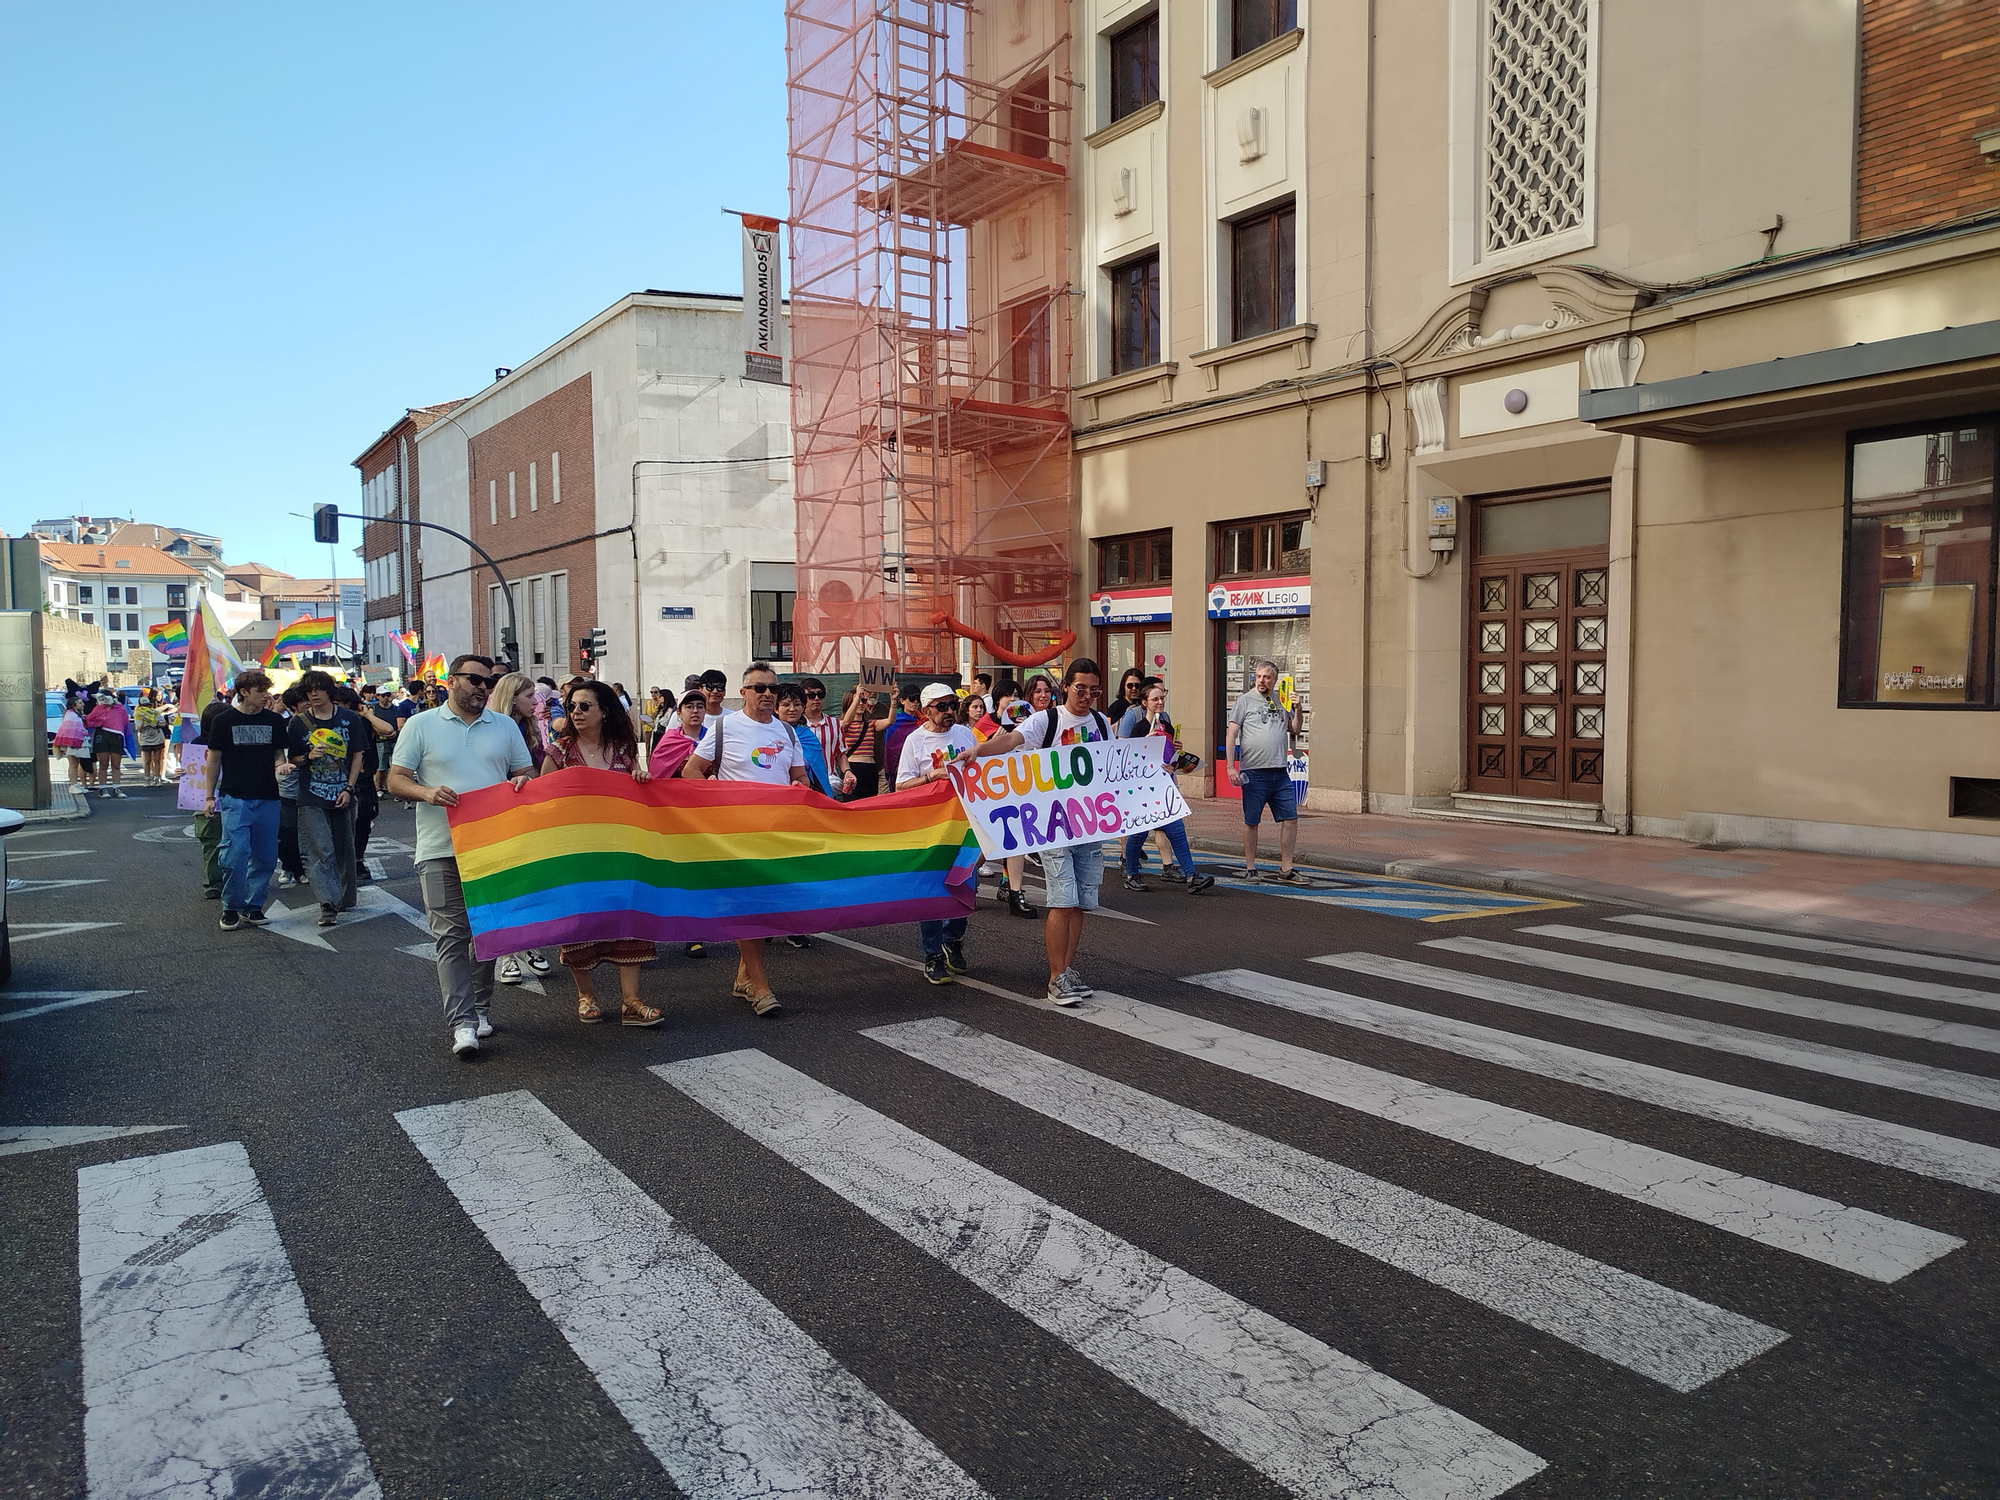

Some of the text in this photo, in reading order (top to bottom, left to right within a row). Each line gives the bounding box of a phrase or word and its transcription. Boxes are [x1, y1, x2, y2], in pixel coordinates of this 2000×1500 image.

[758, 254, 768, 351] AKIANDAMIOS
[1229, 607, 1297, 617] Servicios Inmobiliarios
[1230, 591, 1299, 606] RE/MAX LEGIO
[1133, 614, 1152, 623] negocio
[1103, 743, 1161, 784] libre
[989, 785, 1182, 850] TRANS versal
